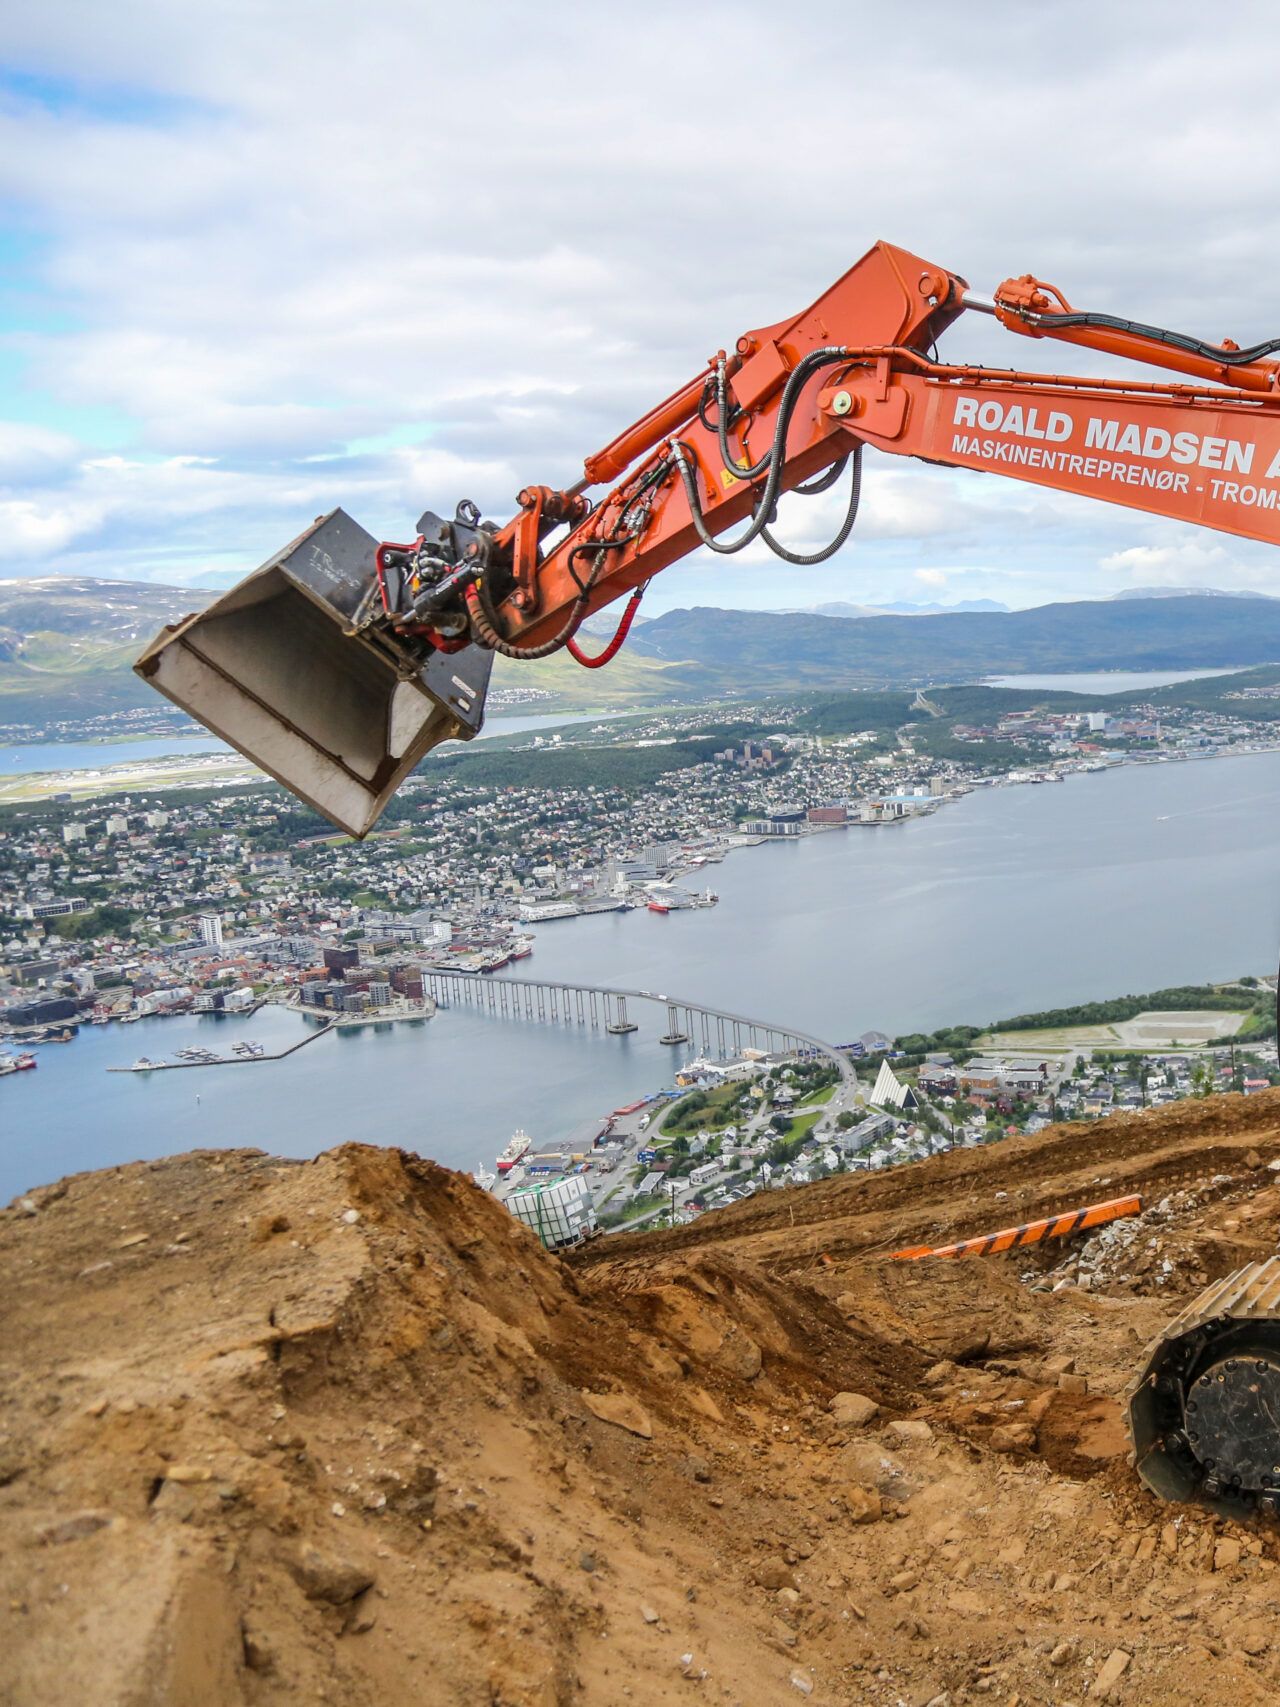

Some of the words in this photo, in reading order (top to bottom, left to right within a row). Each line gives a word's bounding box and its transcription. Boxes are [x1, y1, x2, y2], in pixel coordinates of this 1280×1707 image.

[952, 434, 1190, 494] MASKINENTREPRENØR
[953, 397, 1073, 443] ROALD
[1085, 418, 1255, 474] MADSEN
